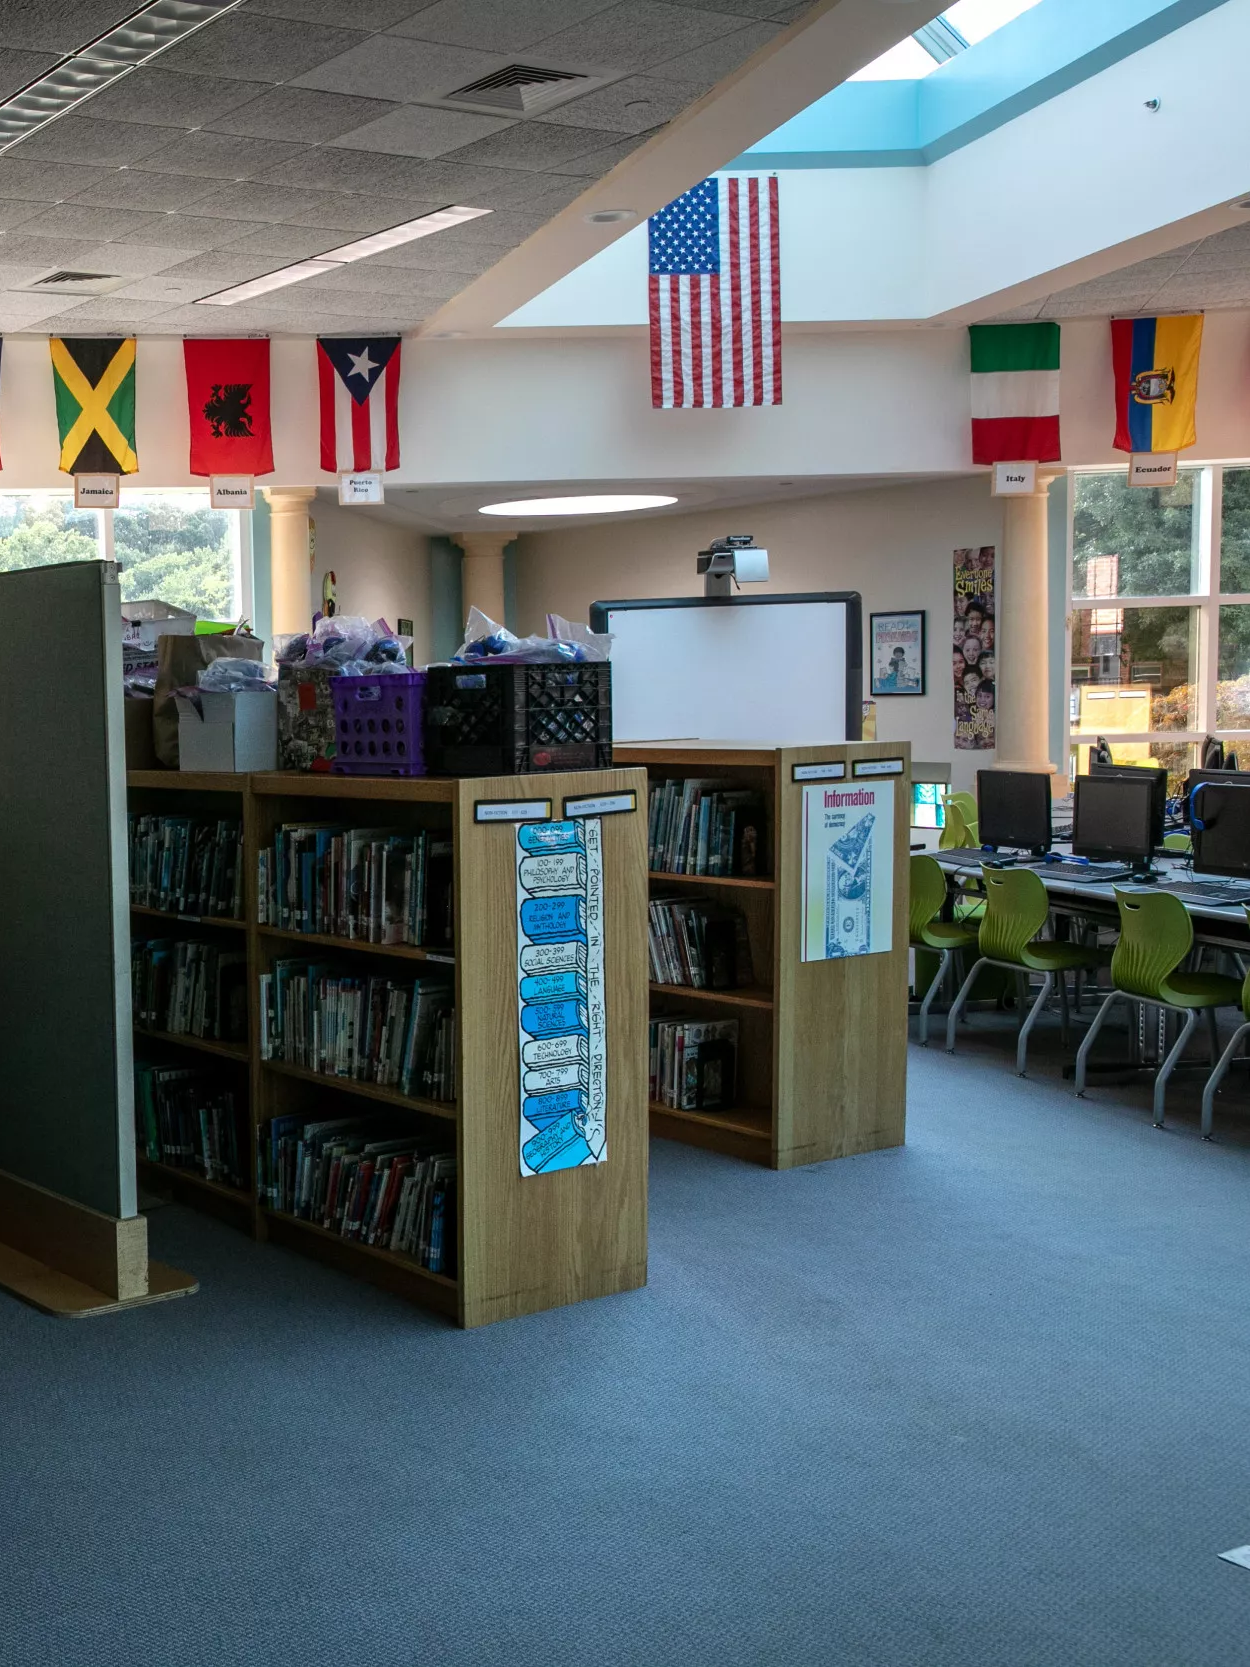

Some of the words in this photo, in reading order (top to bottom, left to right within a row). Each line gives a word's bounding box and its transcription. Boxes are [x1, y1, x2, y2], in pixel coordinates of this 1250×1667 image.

[1135, 466, 1172, 474] Ecuador
[1005, 475, 1026, 483] Italy
[80, 487, 114, 495] Jamaica
[216, 488, 248, 496] Albania
[955, 566, 993, 581] Everyone
[955, 578, 993, 598] Smiles
[964, 691, 977, 704] the
[970, 705, 994, 721] Same
[955, 717, 994, 740] Language
[824, 788, 875, 809] Information
[532, 824, 564, 835] 000-099
[588, 829, 599, 854] GET
[537, 858, 564, 868] 100-199
[523, 868, 559, 877] PHILOSOPHY
[561, 866, 575, 875] AND
[532, 875, 570, 885] PSYCHOLOGY
[590, 868, 600, 921] POINTED
[533, 901, 566, 912] 200-299
[528, 913, 554, 923] RELIGION
[557, 911, 571, 920] AND
[533, 921, 567, 931] MYTHOLOGY
[590, 935, 600, 947] IN
[535, 946, 565, 958] 300-399
[524, 958, 545, 967] SOCIAL
[546, 953, 575, 965] SCIENCES
[534, 975, 564, 986] 400-499
[589, 963, 600, 987] THE
[533, 983, 566, 996] LANGUAGE
[535, 1003, 565, 1015] 500-599
[537, 1011, 565, 1022] NATURAL
[591, 1003, 602, 1038] RIGHT
[537, 1020, 566, 1029] SCIENCES
[537, 1040, 568, 1052] 600-699
[533, 1048, 572, 1060] TECHNOLOGY
[538, 1067, 569, 1079] 700-799
[545, 1077, 561, 1086] ARTS
[593, 1053, 603, 1110] DIRECTION
[538, 1093, 568, 1105] 800-899
[536, 1101, 571, 1113] LITERATURE
[531, 1121, 560, 1146] 900-999
[525, 1133, 559, 1160] GEOGRAPHY
[560, 1121, 571, 1135] AND
[540, 1136, 564, 1158] HISTORY
